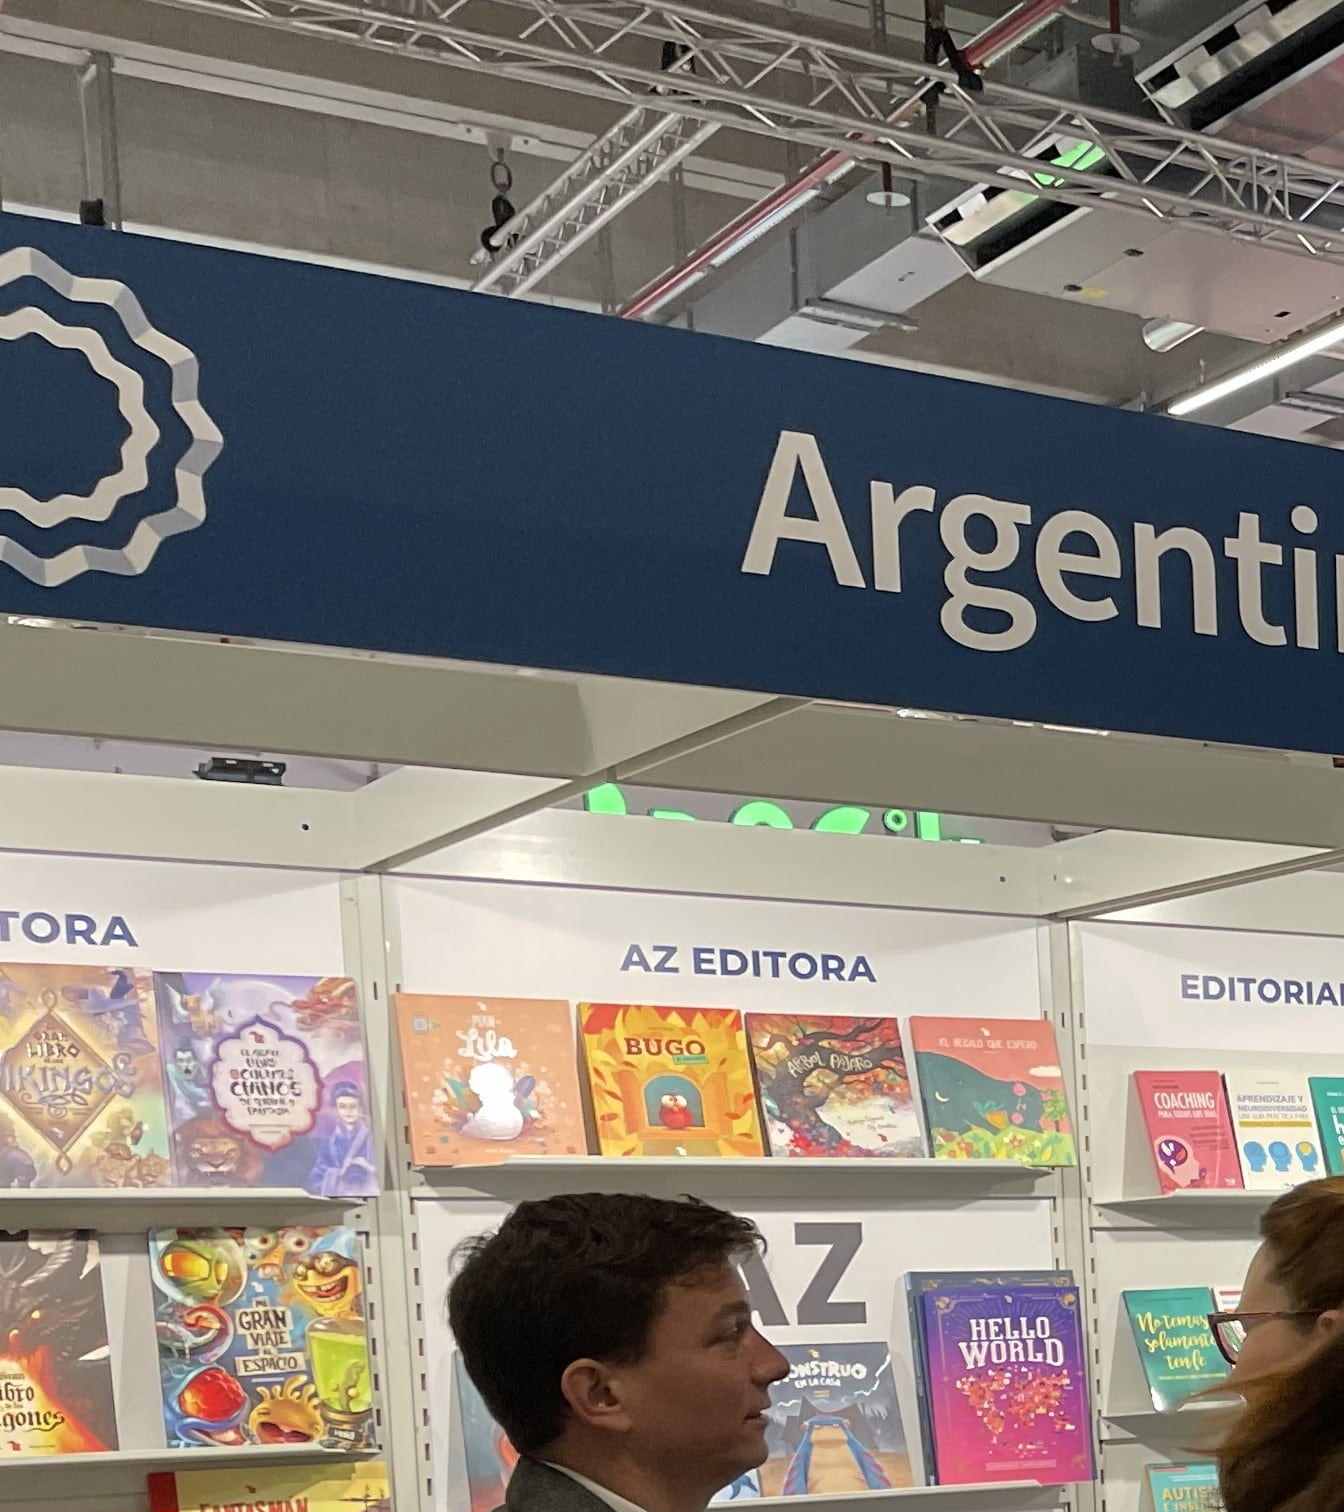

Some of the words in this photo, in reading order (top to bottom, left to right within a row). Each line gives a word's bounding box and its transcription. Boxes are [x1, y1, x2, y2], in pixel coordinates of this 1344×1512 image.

[620, 944, 680, 973] AZ
[693, 947, 877, 983] EDITORA
[624, 1037, 706, 1057] BUGO
[1154, 1092, 1215, 1109] COACHING
[240, 1309, 287, 1330] GRAN
[969, 1317, 1050, 1341] HELLO
[1136, 1312, 1160, 1334] No
[958, 1337, 1064, 1369] WORLD
[243, 1357, 297, 1373] ESPACIO
[773, 1360, 867, 1385] ONSTRUO
[0, 1411, 65, 1432] gones
